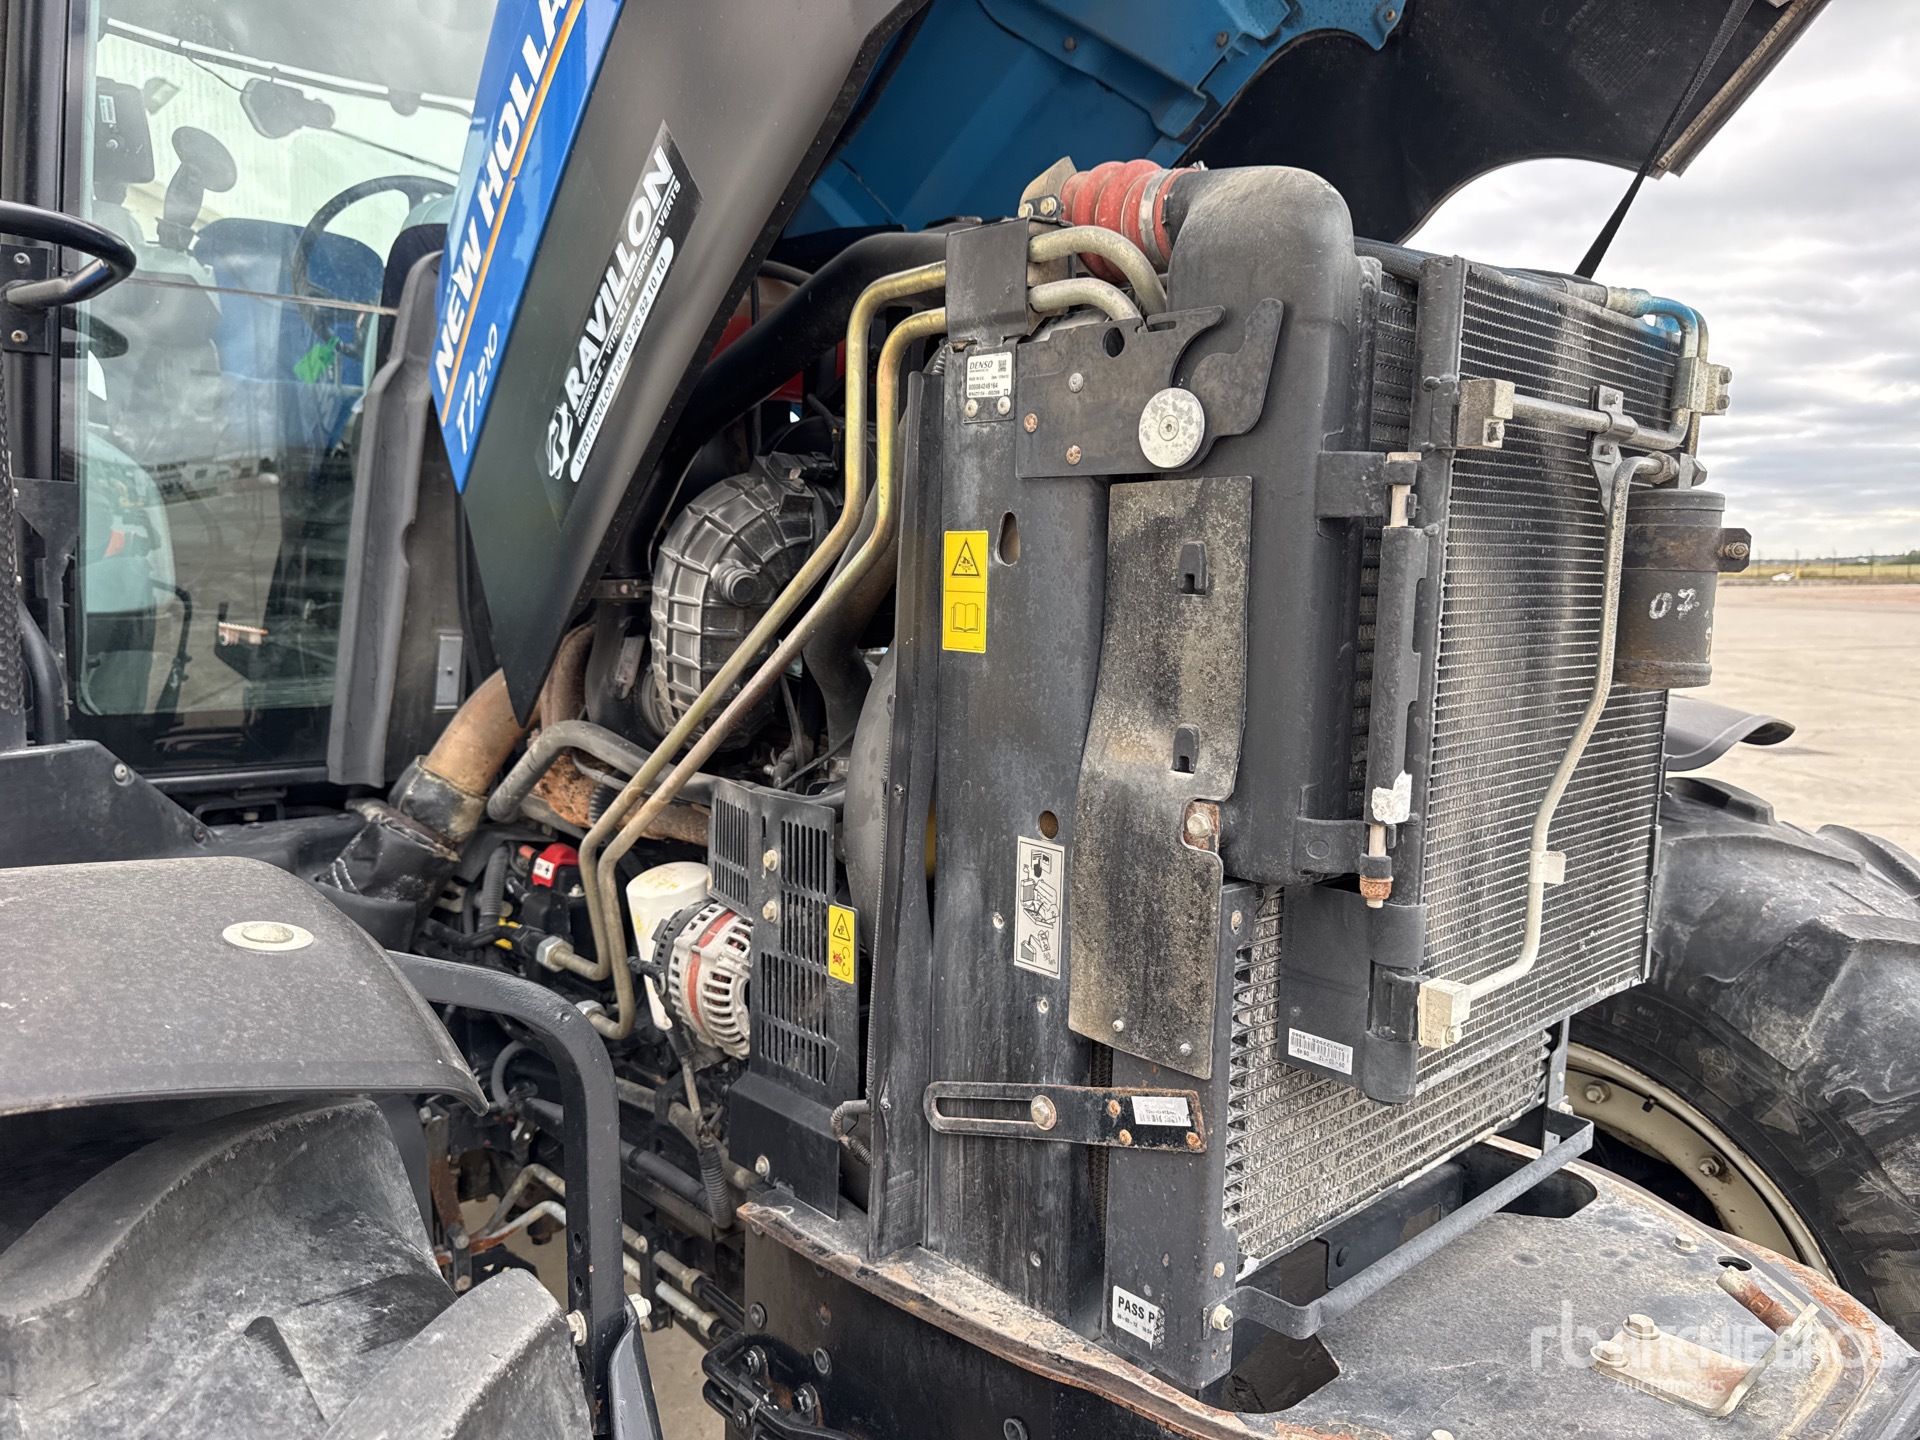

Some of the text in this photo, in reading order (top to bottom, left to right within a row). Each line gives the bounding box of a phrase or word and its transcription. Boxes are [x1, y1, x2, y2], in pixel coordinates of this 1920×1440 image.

[435, 216, 482, 395] NEW
[564, 145, 674, 411] RAVILLON
[576, 378, 615, 465] VERT-TOULON
[623, 333, 634, 353] 03
[632, 314, 641, 334] 26
[639, 296, 649, 317] 52
[648, 276, 658, 296] 10
[656, 256, 666, 276] 10
[578, 366, 604, 427] AGRICOLE
[605, 298, 632, 355] VITICOLE
[633, 227, 662, 289] ESPACES
[658, 180, 681, 226] VERTS
[969, 360, 994, 370] DENSO
[456, 322, 498, 455] T7.210
[1118, 1295, 1145, 1320] PASS
